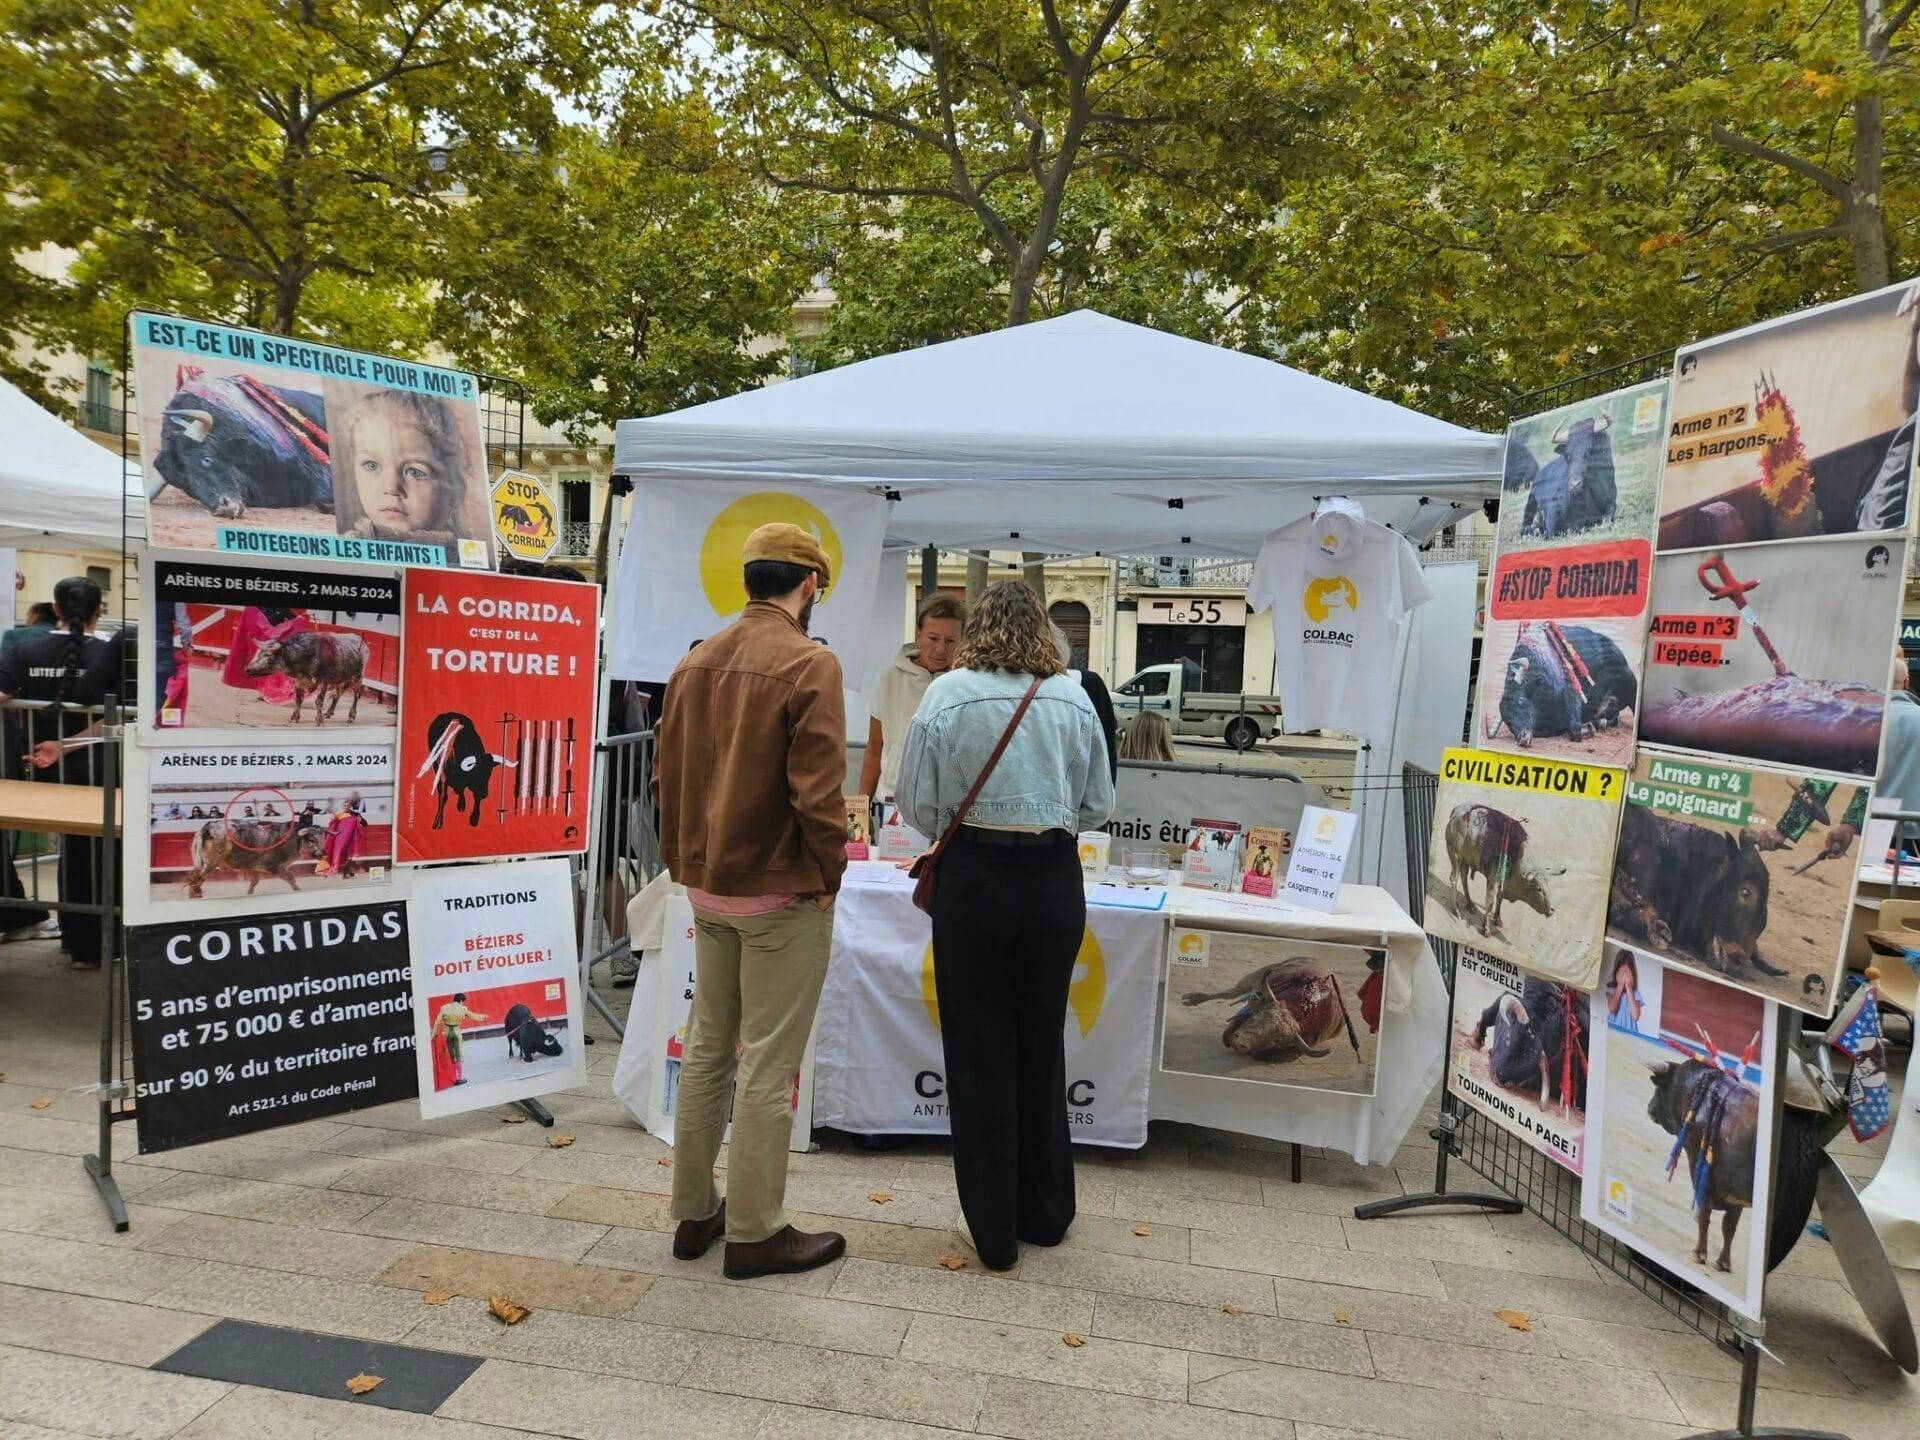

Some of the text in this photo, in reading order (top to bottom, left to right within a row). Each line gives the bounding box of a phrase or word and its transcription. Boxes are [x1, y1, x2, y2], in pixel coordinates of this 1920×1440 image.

[148, 321, 473, 397] EST-CE UN SPECTACLE POUR MOI ?
[1670, 406, 1746, 438] Arme n°2
[1667, 432, 1783, 464] Les harpons...
[507, 480, 540, 500] STOP
[225, 530, 441, 565] PROTEGEONS LES ENFANTS !
[506, 533, 547, 549] CORRIDA
[164, 571, 222, 589] ARÈNES
[225, 578, 242, 590] DE
[246, 576, 299, 594] BÉZIERS
[310, 584, 319, 595] 2
[321, 584, 357, 597] MARS
[360, 587, 393, 600] 2024
[1498, 559, 1638, 602] #STOP CORRIDA
[417, 593, 581, 627] LA CORRIDA,
[1168, 600, 1222, 624] Le 55
[469, 628, 538, 642] C'EST DE LA
[1303, 629, 1354, 643] COLBAC
[1650, 616, 1735, 636] Arme n°3
[427, 648, 577, 677] TORTURE !
[1656, 644, 1731, 667] l'épée...
[161, 752, 217, 767] ARÈNES
[221, 755, 237, 766] DE
[241, 752, 294, 766] BÉZIERS
[305, 755, 314, 765] 2
[317, 755, 353, 765] MARS
[356, 755, 388, 765] 2024
[1445, 758, 1613, 796] CIVILISATION ?
[1650, 762, 1741, 793] Arme n°4
[1628, 782, 1649, 801] Le
[1653, 789, 1743, 819] poignard
[1159, 820, 1190, 844] êtr
[444, 890, 538, 911] TRADITIONS
[166, 911, 402, 966] CORRIDAS
[464, 932, 525, 952] BÉZIERS
[434, 949, 553, 977] DOIT ÉVOLUER !
[1462, 956, 1523, 993] EST CRUELLE
[1464, 945, 1518, 978] LA CORRIDA
[136, 1000, 153, 1021] 5
[161, 995, 208, 1018] ans
[161, 1028, 190, 1050] et
[196, 1021, 229, 1045] 75
[235, 1012, 282, 1038] 000
[288, 1009, 305, 1029] €
[136, 1078, 174, 1098] sur
[180, 1068, 209, 1091] 90
[214, 1063, 235, 1085] %
[240, 1059, 269, 1079] du
[275, 1042, 368, 1074] territoire
[228, 1076, 377, 1117] Art 521-1 du Code Pénal
[1457, 1073, 1516, 1120] TOURNONS
[1518, 1111, 1533, 1131] LA
[1535, 1123, 1570, 1154] PAGE
